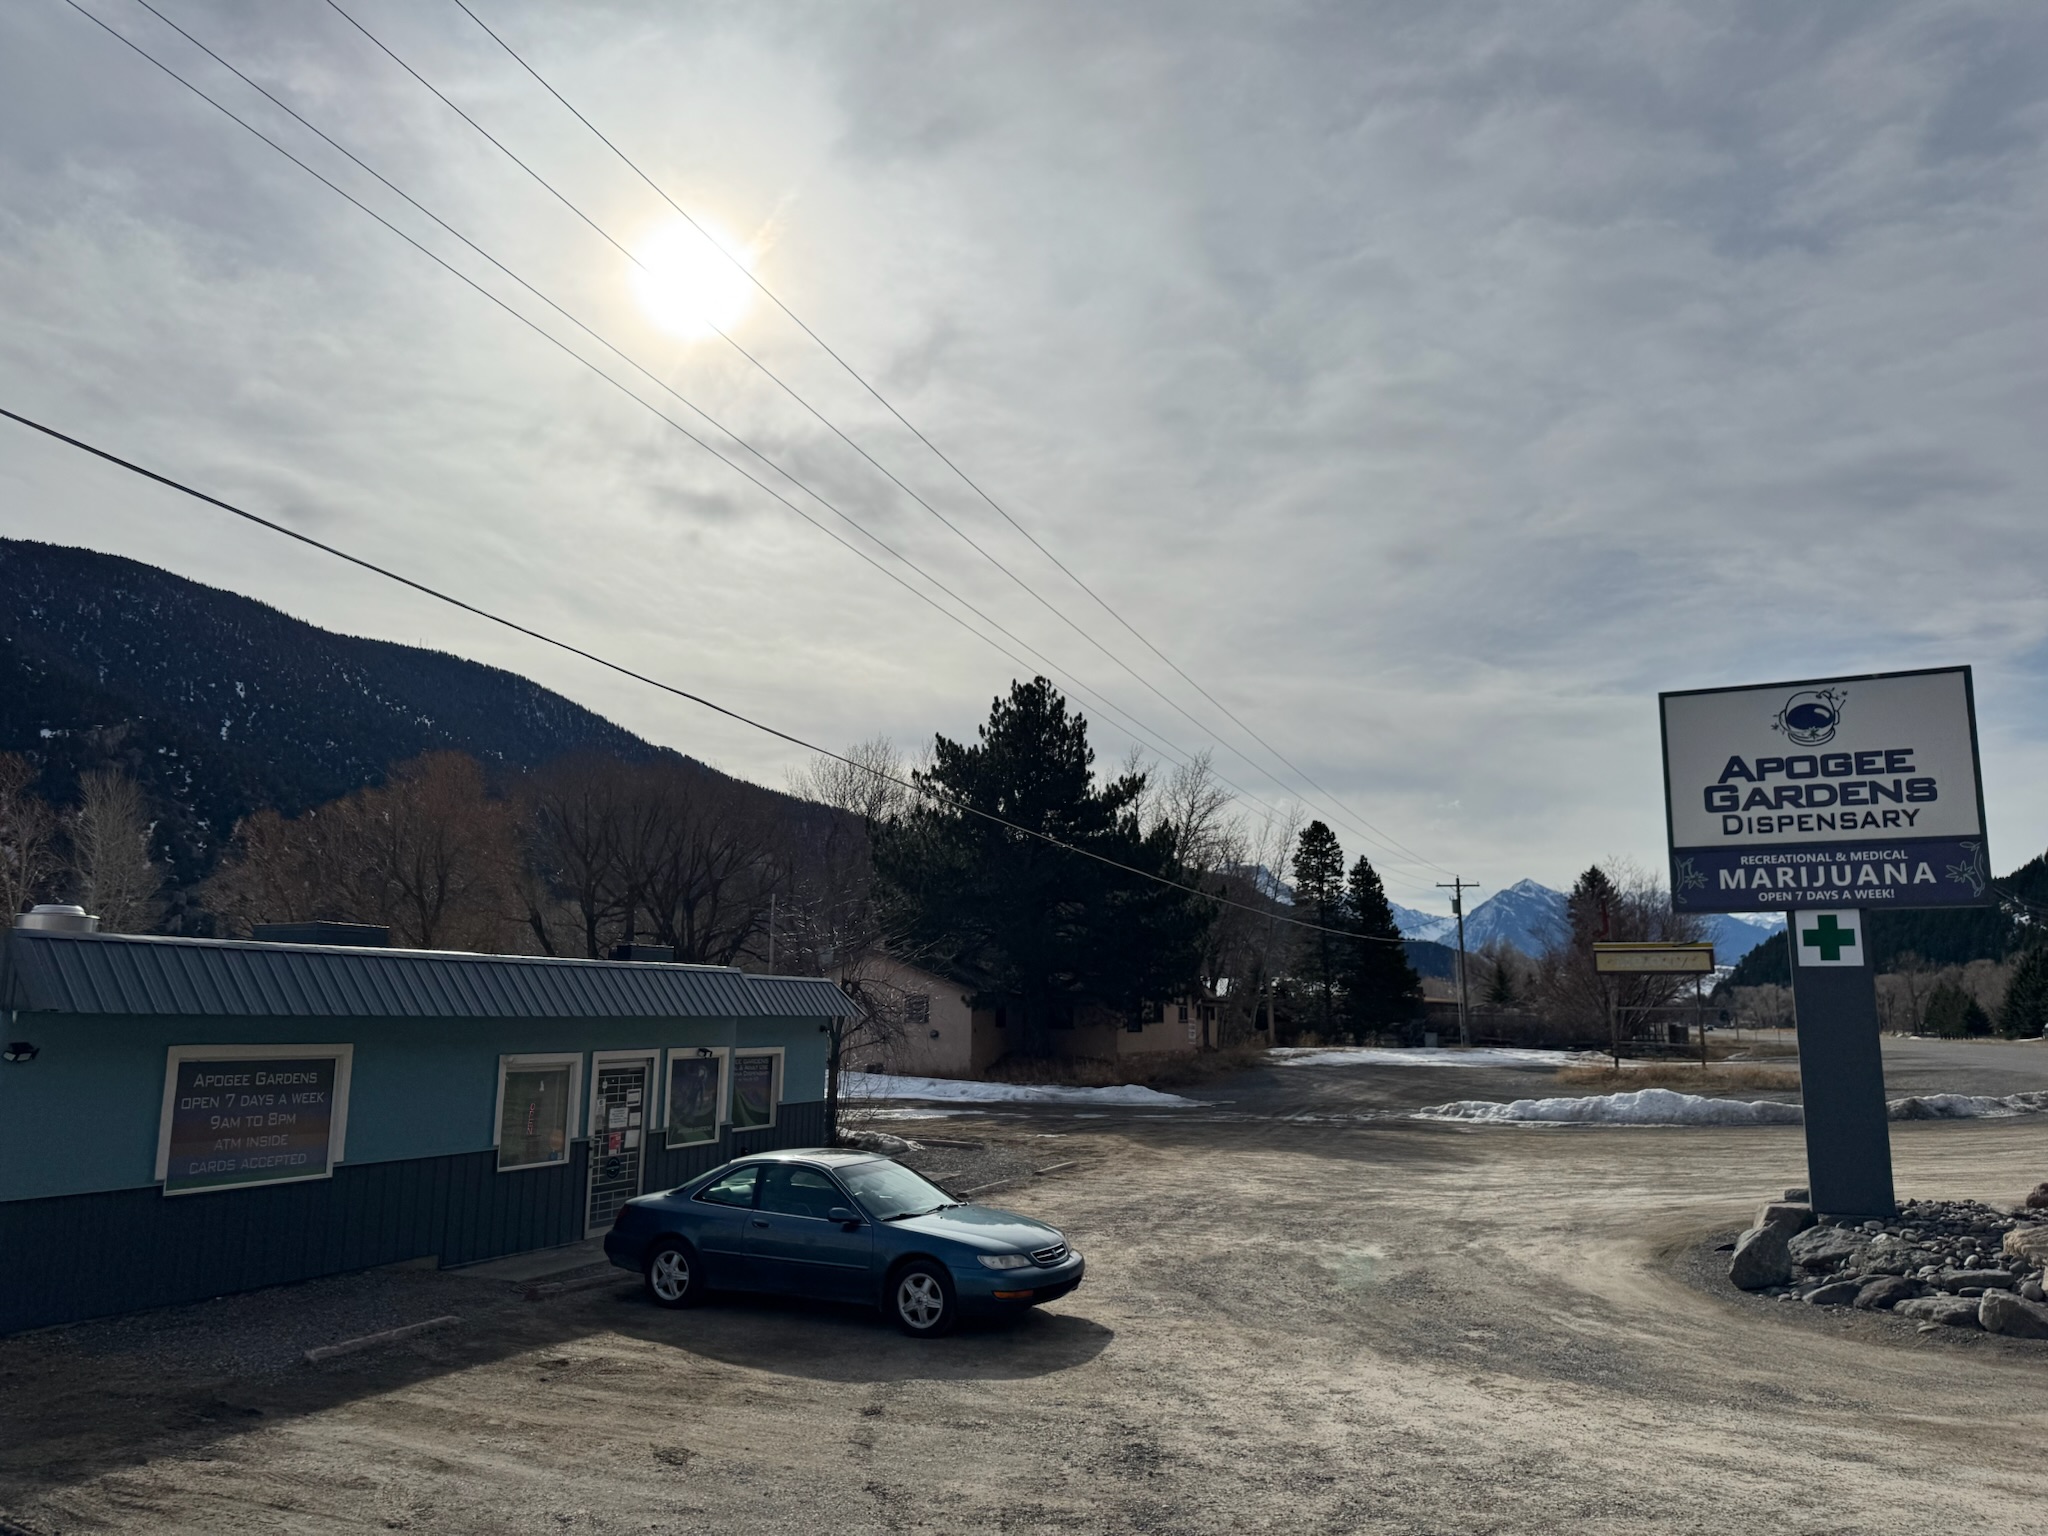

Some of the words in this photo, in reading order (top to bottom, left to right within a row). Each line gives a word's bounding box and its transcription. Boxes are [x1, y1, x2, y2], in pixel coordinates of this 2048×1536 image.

[1717, 748, 1916, 784] APOGEE
[1703, 777, 1938, 813] GARDENS
[1722, 808, 1921, 836] DISPENSARY
[1740, 853, 1832, 865] RECREATIONAL
[1835, 852, 1847, 861] &
[1850, 849, 1908, 861] MEDICAL
[1718, 861, 1937, 890] MARIJUANA
[1758, 891, 1792, 902] OPEN
[1795, 891, 1803, 901] 7
[1806, 889, 1839, 901] DAYS
[1842, 889, 1851, 899] A
[1854, 888, 1895, 899] WEEK!
[193, 1074, 251, 1088] APOGEE
[255, 1072, 318, 1086] GARDENS
[181, 1096, 220, 1109] OPEN
[225, 1093, 236, 1108] 7
[240, 1094, 274, 1106] DAYS
[278, 1093, 287, 1104] A
[291, 1092, 325, 1104] WEEK
[210, 1115, 240, 1130] 9AM
[246, 1115, 263, 1127] TO
[268, 1112, 296, 1126] 8PM
[527, 1102, 536, 1136] OPEN
[214, 1138, 241, 1151] ATM
[246, 1134, 289, 1148] INSIDE
[189, 1159, 235, 1175] CARDS
[240, 1153, 307, 1169] ACCEPTED
